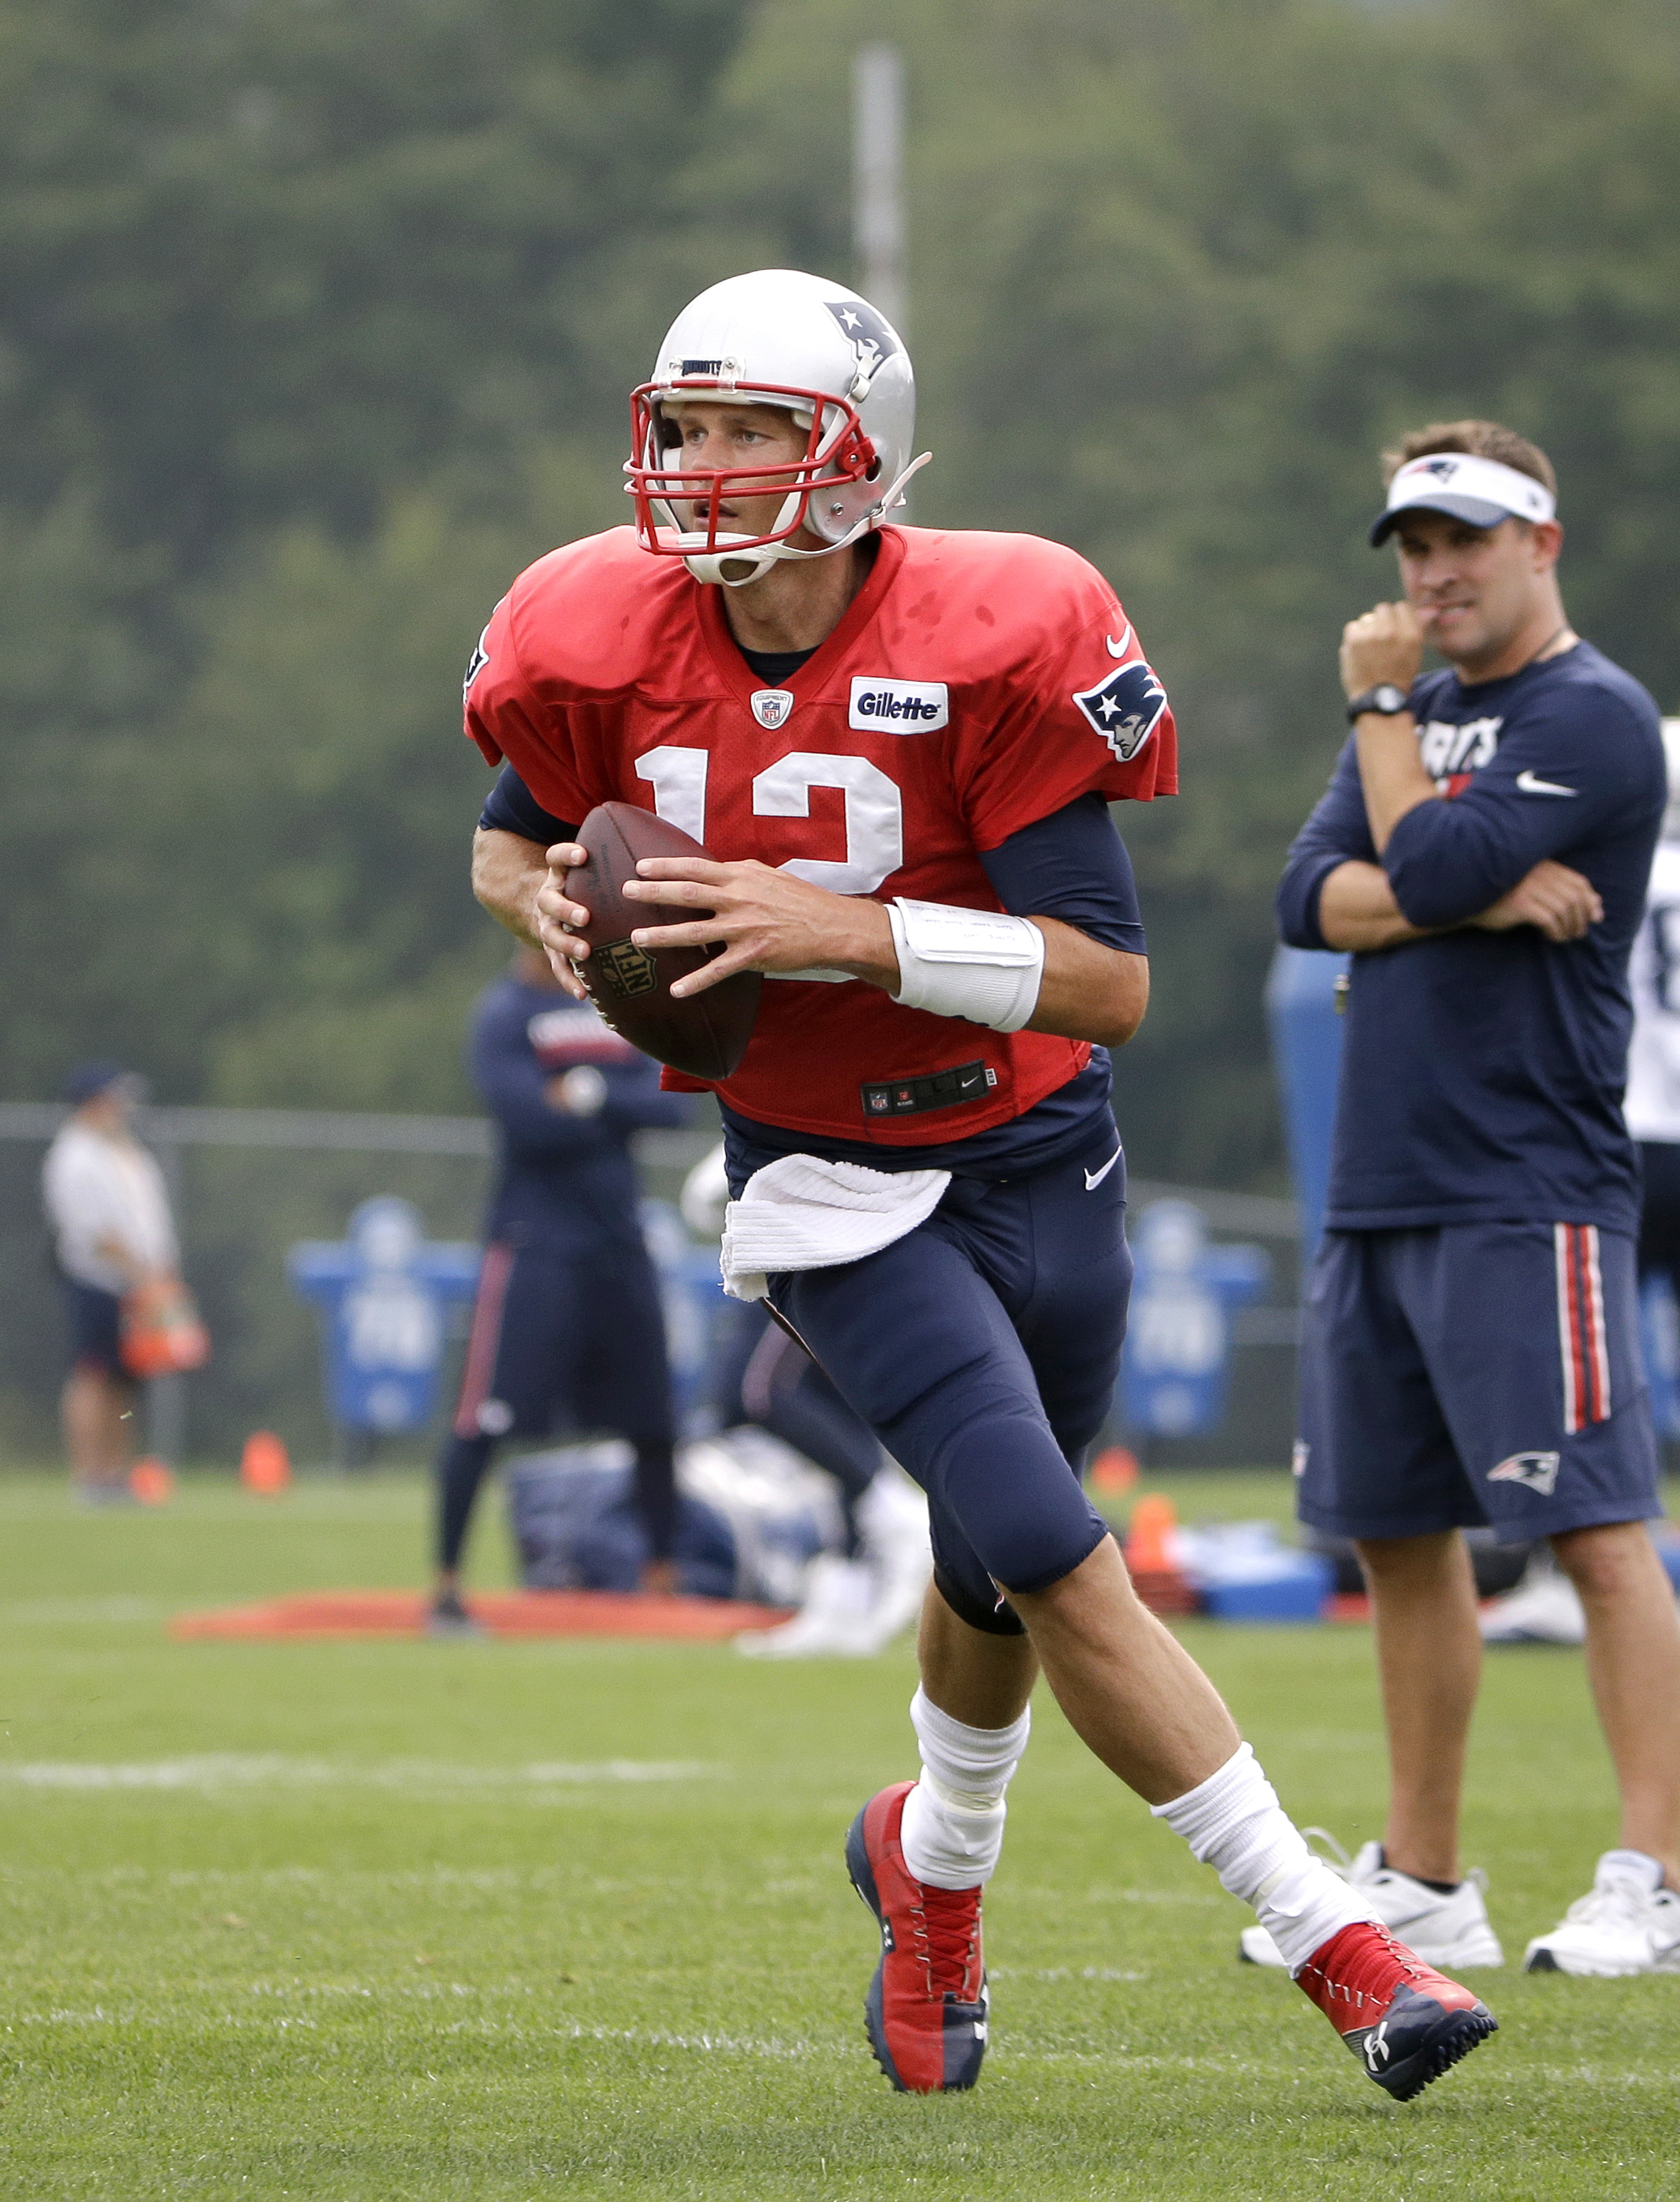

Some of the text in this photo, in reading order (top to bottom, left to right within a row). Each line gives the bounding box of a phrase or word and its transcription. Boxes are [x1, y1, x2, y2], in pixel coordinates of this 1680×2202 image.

[764, 710, 779, 720] NFL
[858, 692, 938, 720] Gillette
[614, 943, 651, 993] NFL
